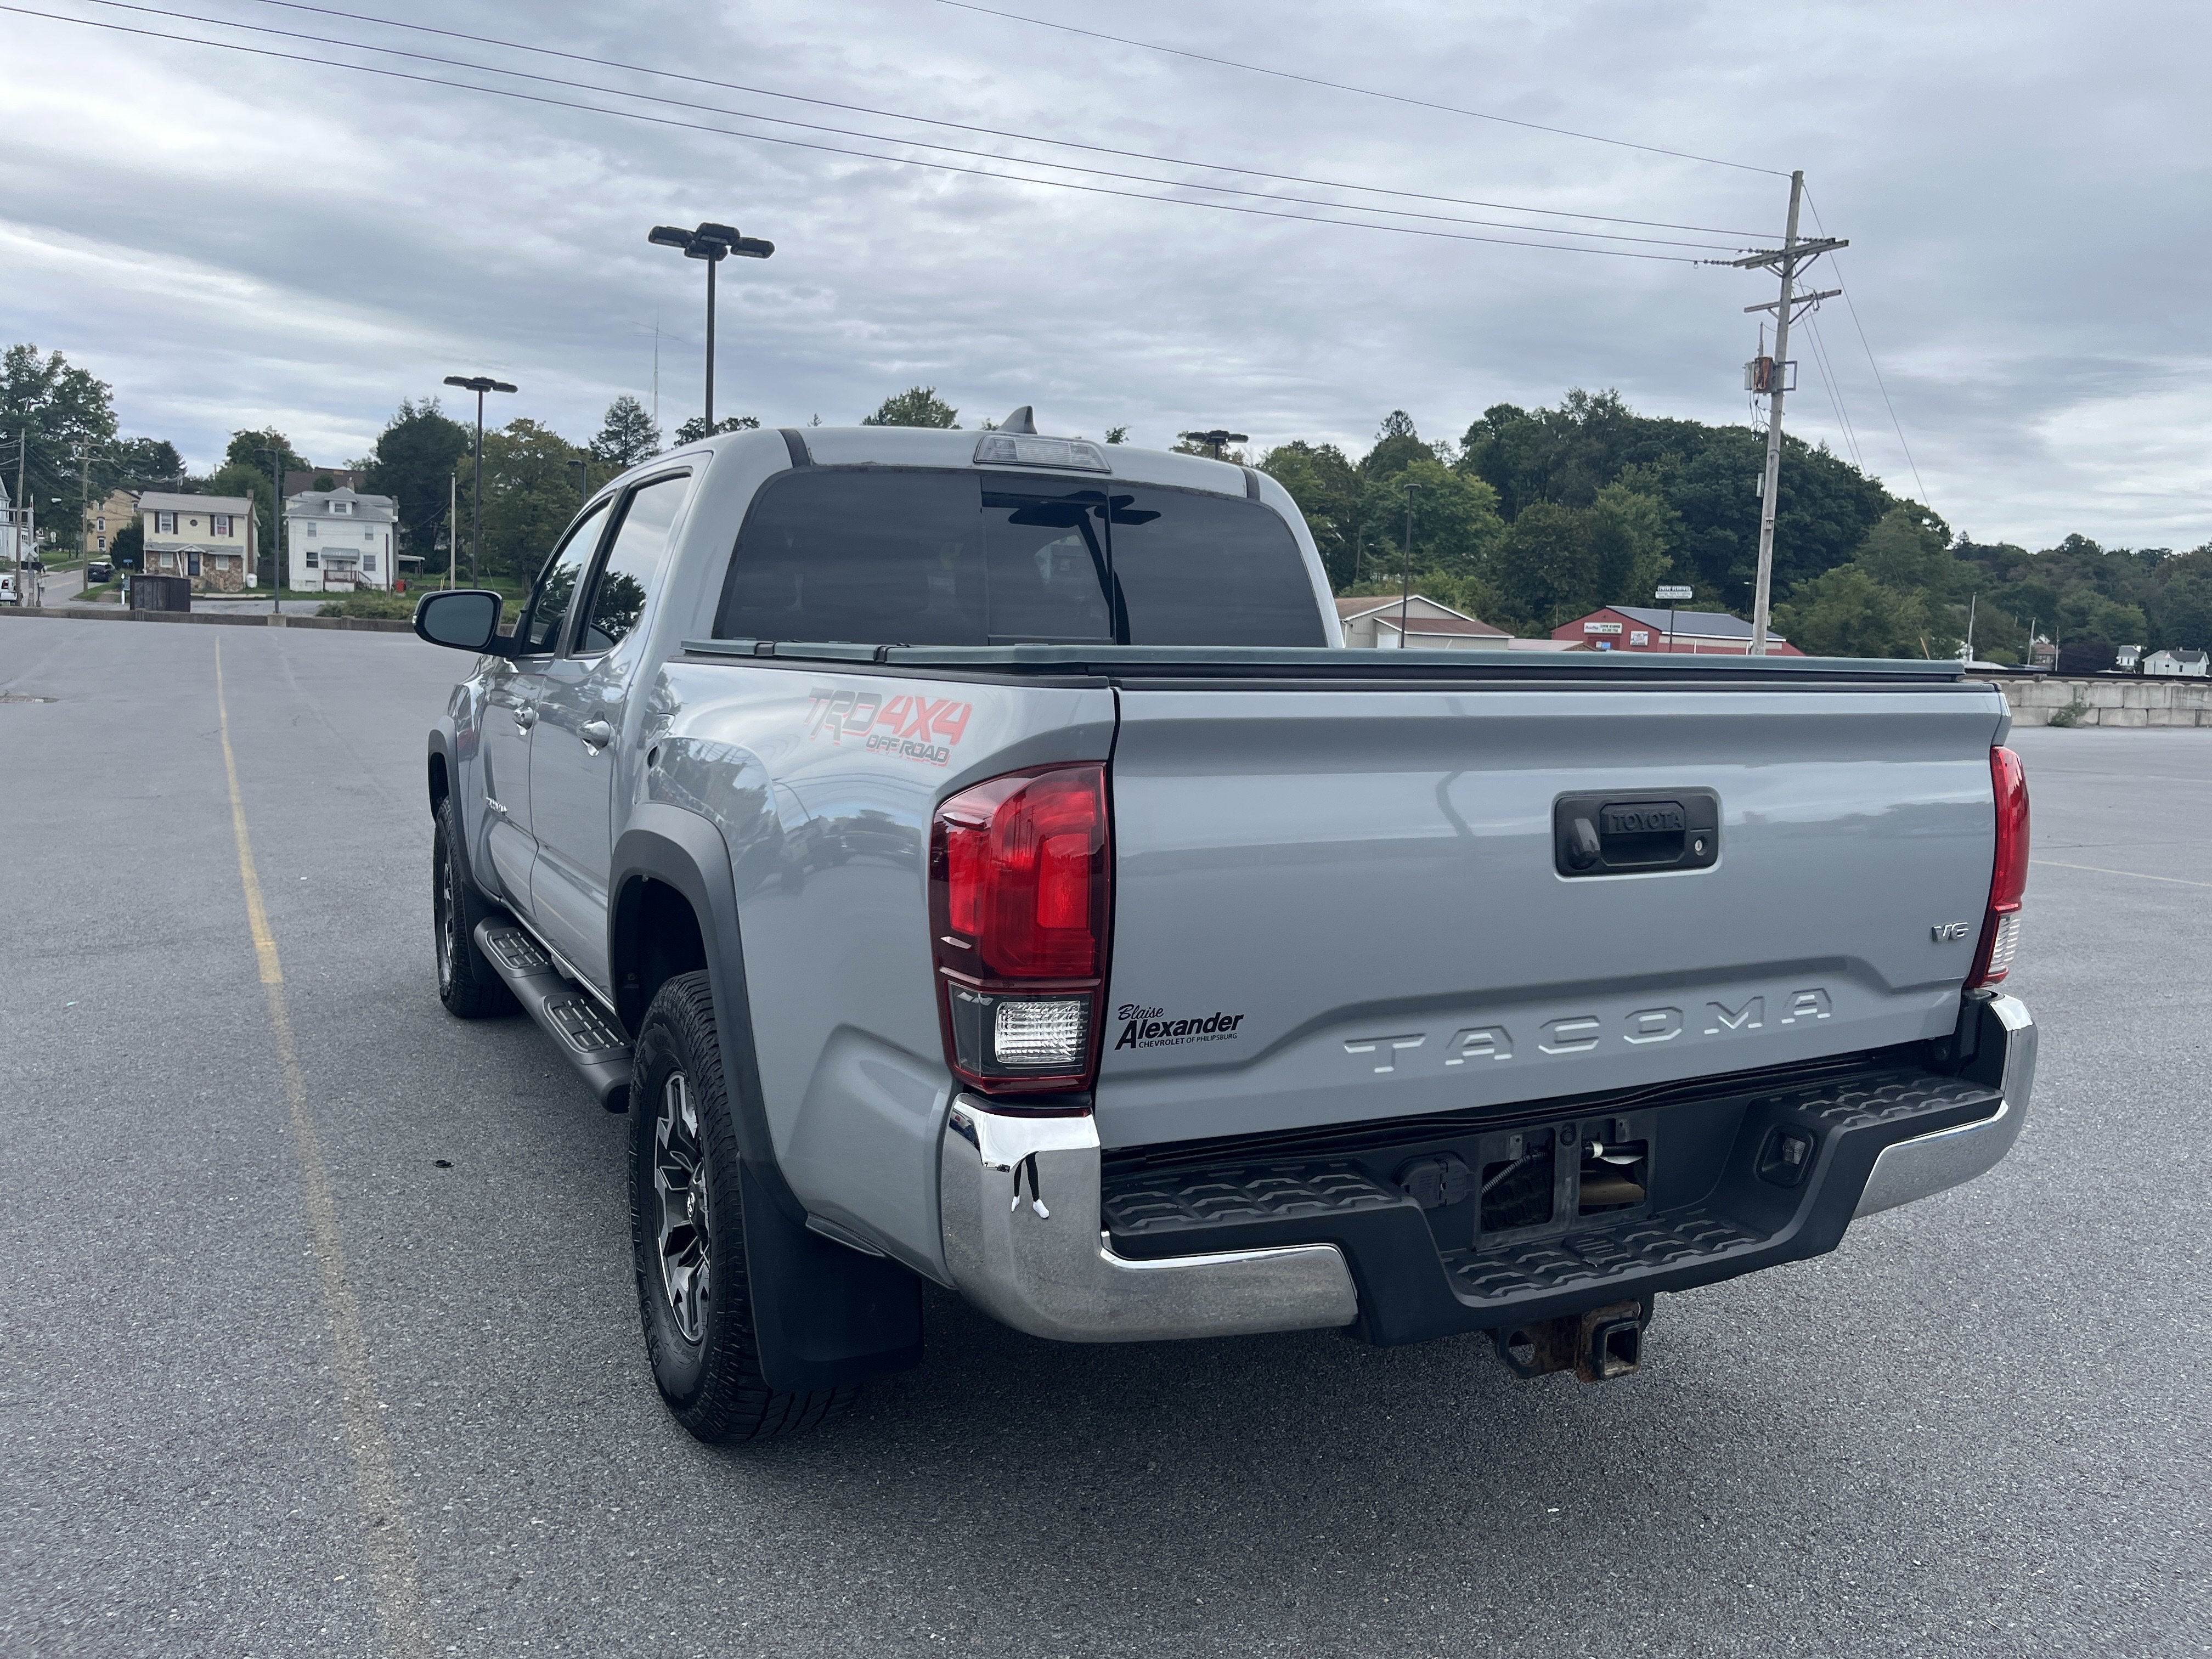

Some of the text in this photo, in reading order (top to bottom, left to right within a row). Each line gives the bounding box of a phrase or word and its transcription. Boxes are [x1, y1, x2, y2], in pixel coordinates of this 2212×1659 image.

[803, 687, 973, 747] TRD 4X4
[866, 735, 951, 768] OFF ROAD
[1611, 810, 1683, 832] TOYOTA
[1931, 922, 1969, 942] V6
[1118, 1003, 1164, 1020] Blaise
[1114, 1012, 1245, 1051] Alexander
[1138, 1037, 1184, 1048] CHEVROLET
[1197, 1033, 1238, 1042] PHILIPSBURG
[1344, 987, 1832, 1073] TACOMA
